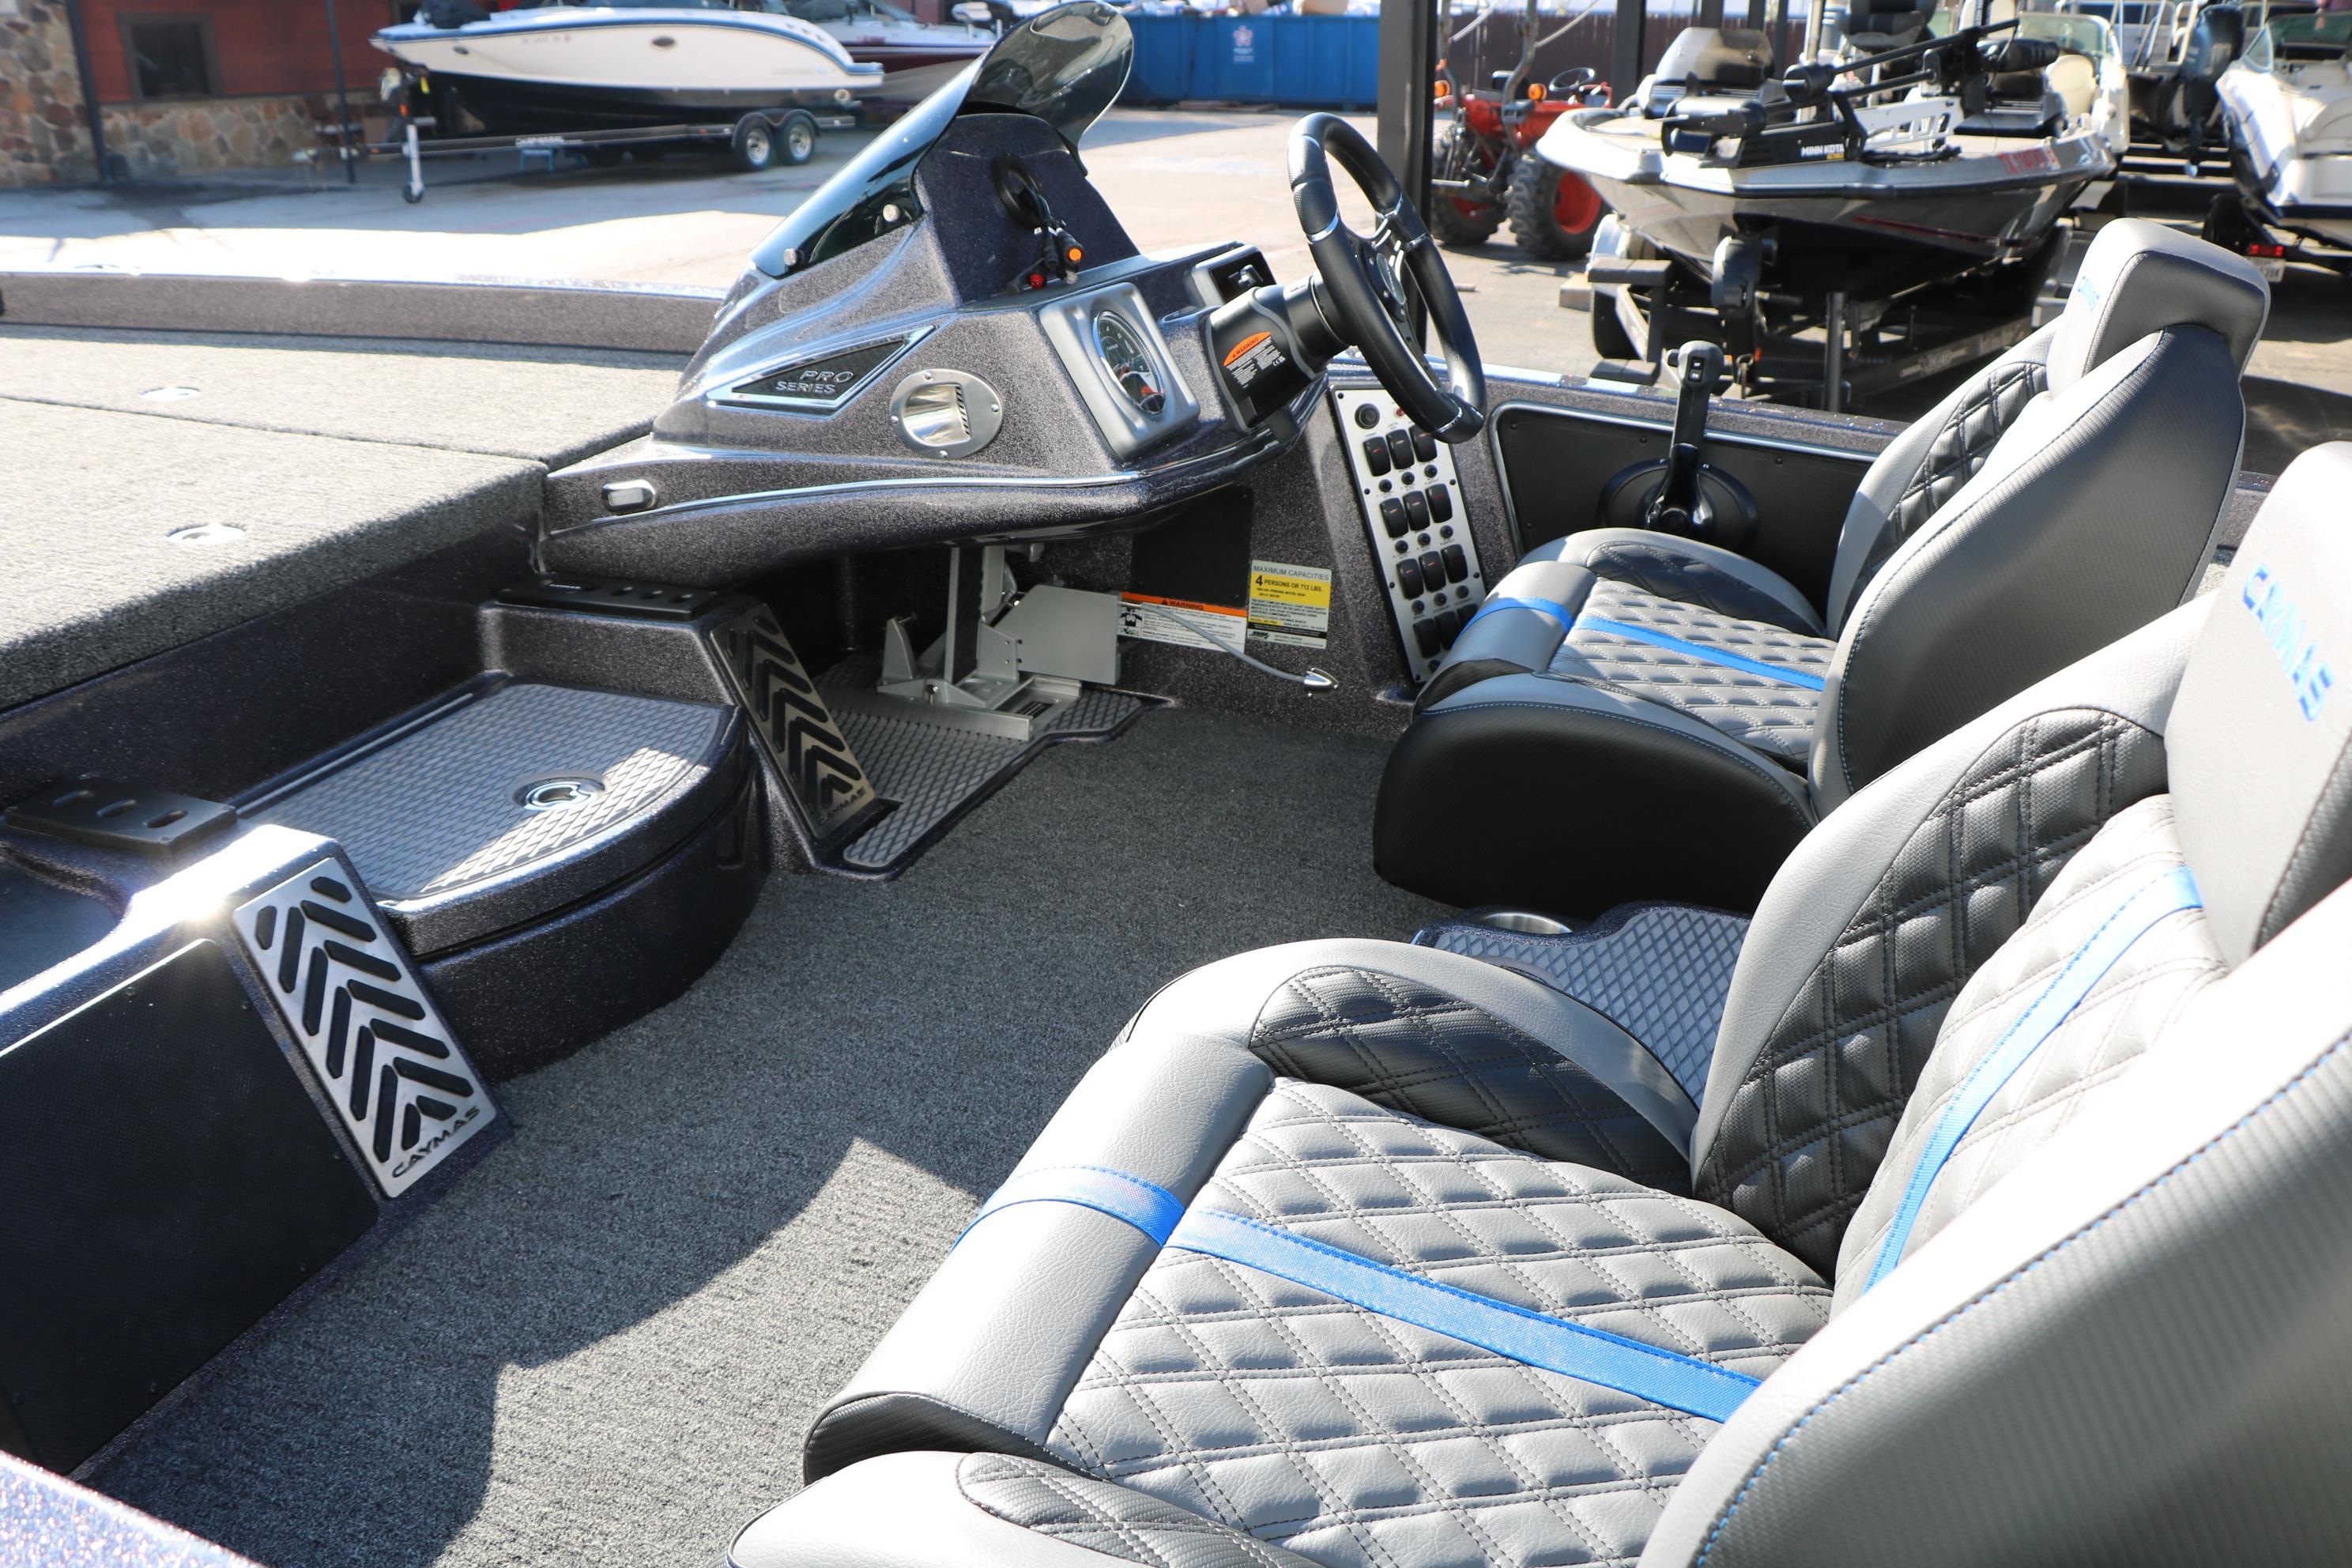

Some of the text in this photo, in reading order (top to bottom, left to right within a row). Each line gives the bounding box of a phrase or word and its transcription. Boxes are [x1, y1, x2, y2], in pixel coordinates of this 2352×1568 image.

[1801, 145, 1823, 157] MINN
[1824, 143, 1845, 154] KOTA
[1236, 337, 1259, 356] WARNING
[799, 369, 854, 383] PRO
[775, 380, 835, 394] SERIES
[1253, 565, 1329, 581] MAXIMUM CAPACITIES
[1255, 575, 1263, 586] 4
[1265, 579, 1290, 588] PERSONS
[1169, 600, 1204, 611] WARNING
[392, 1106, 481, 1178] CAYMAS
